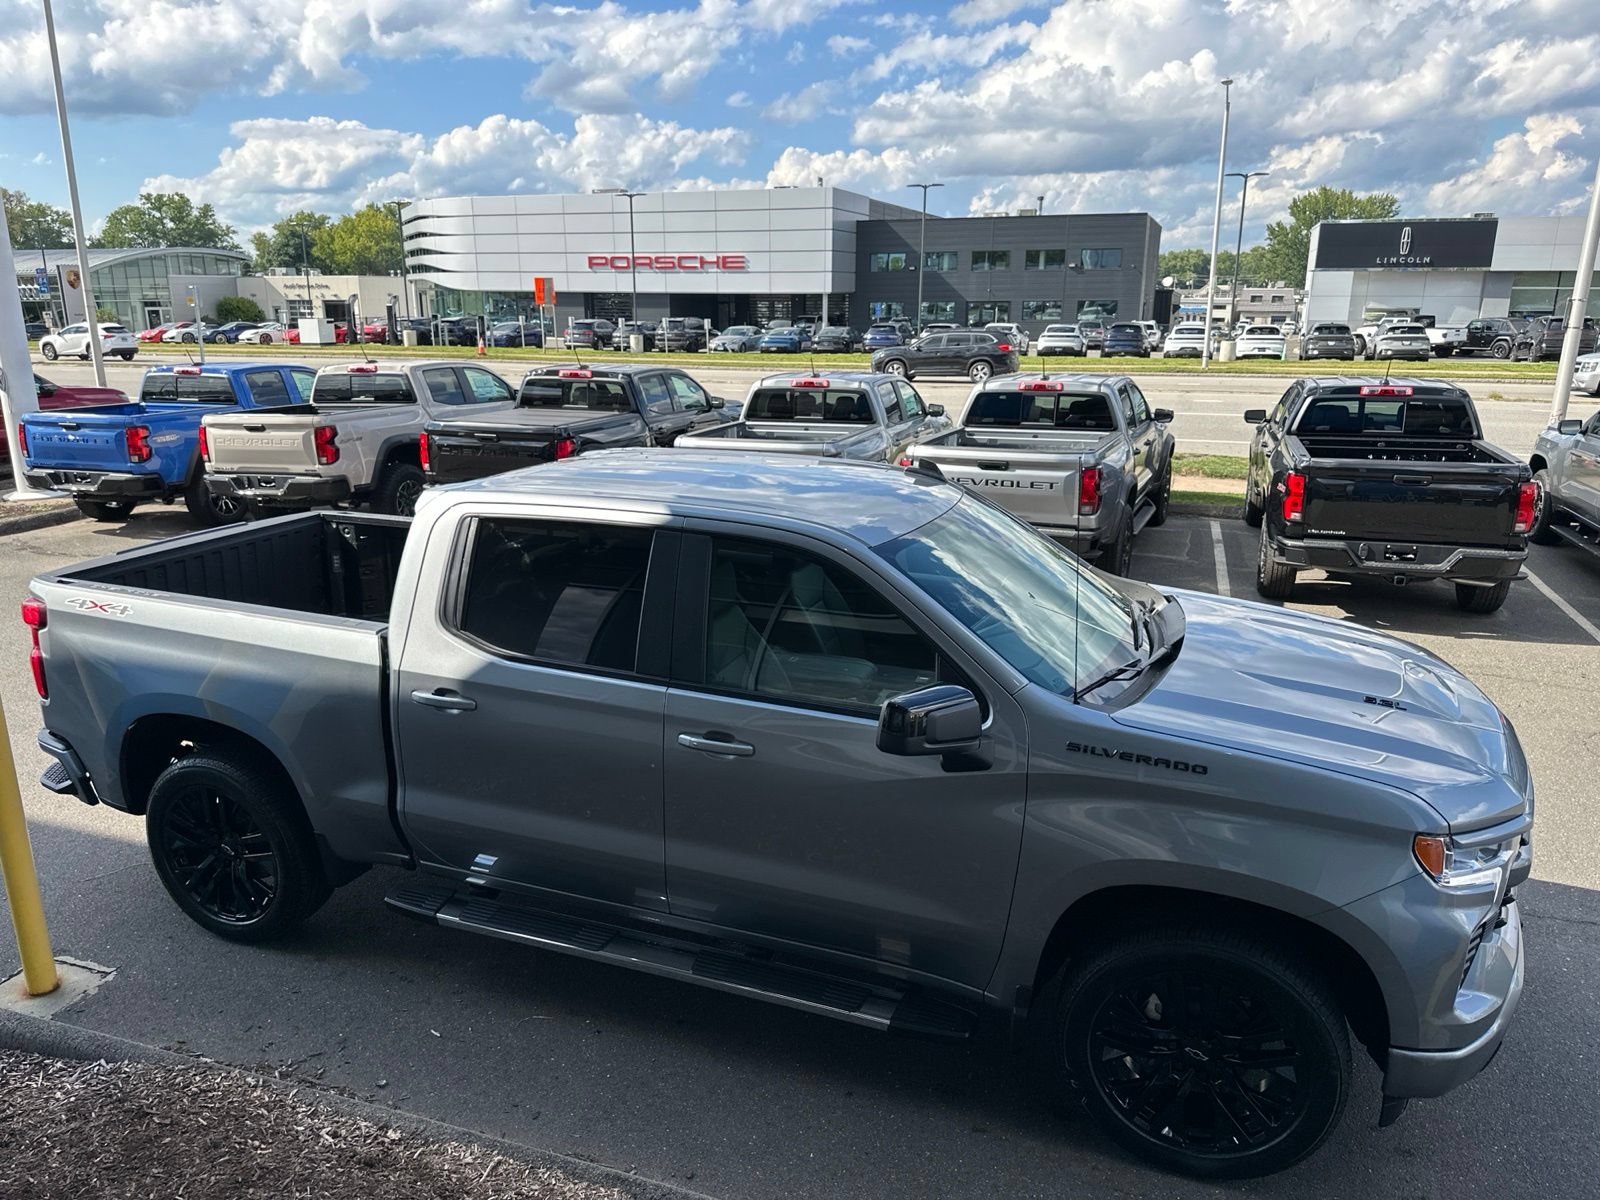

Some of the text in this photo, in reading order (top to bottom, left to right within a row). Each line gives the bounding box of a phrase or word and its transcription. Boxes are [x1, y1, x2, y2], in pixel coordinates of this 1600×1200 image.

[588, 255, 748, 273] PORSCHE
[215, 437, 301, 447] CHEVROLET
[951, 477, 1059, 490] EVROLET
[1065, 741, 1208, 775] SILVERADO
